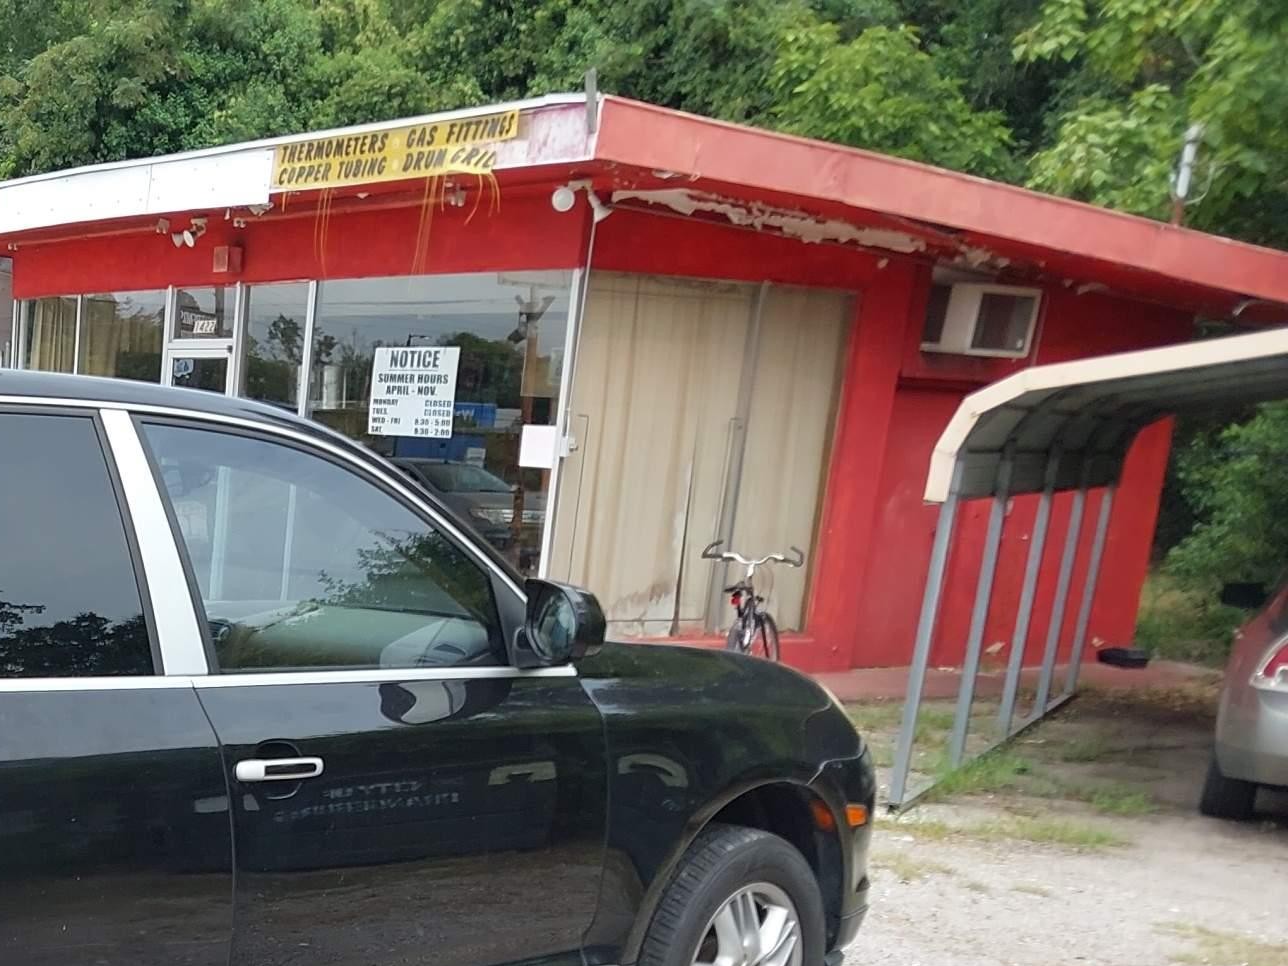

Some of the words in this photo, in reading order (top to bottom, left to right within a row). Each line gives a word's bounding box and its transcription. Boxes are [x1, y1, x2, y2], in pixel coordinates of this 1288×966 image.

[280, 133, 389, 163] THERMOMETERS
[406, 125, 438, 149] GAS
[446, 113, 515, 144] FITTINGS
[278, 162, 332, 185] COPPER
[337, 156, 387, 179] TUBING
[389, 350, 440, 368] NOTICE
[378, 373, 415, 384] SUMMER
[417, 374, 449, 384] HOURS
[386, 385, 409, 395] APRIL
[425, 400, 452, 408] CLOSED
[424, 409, 451, 417] CLOSED
